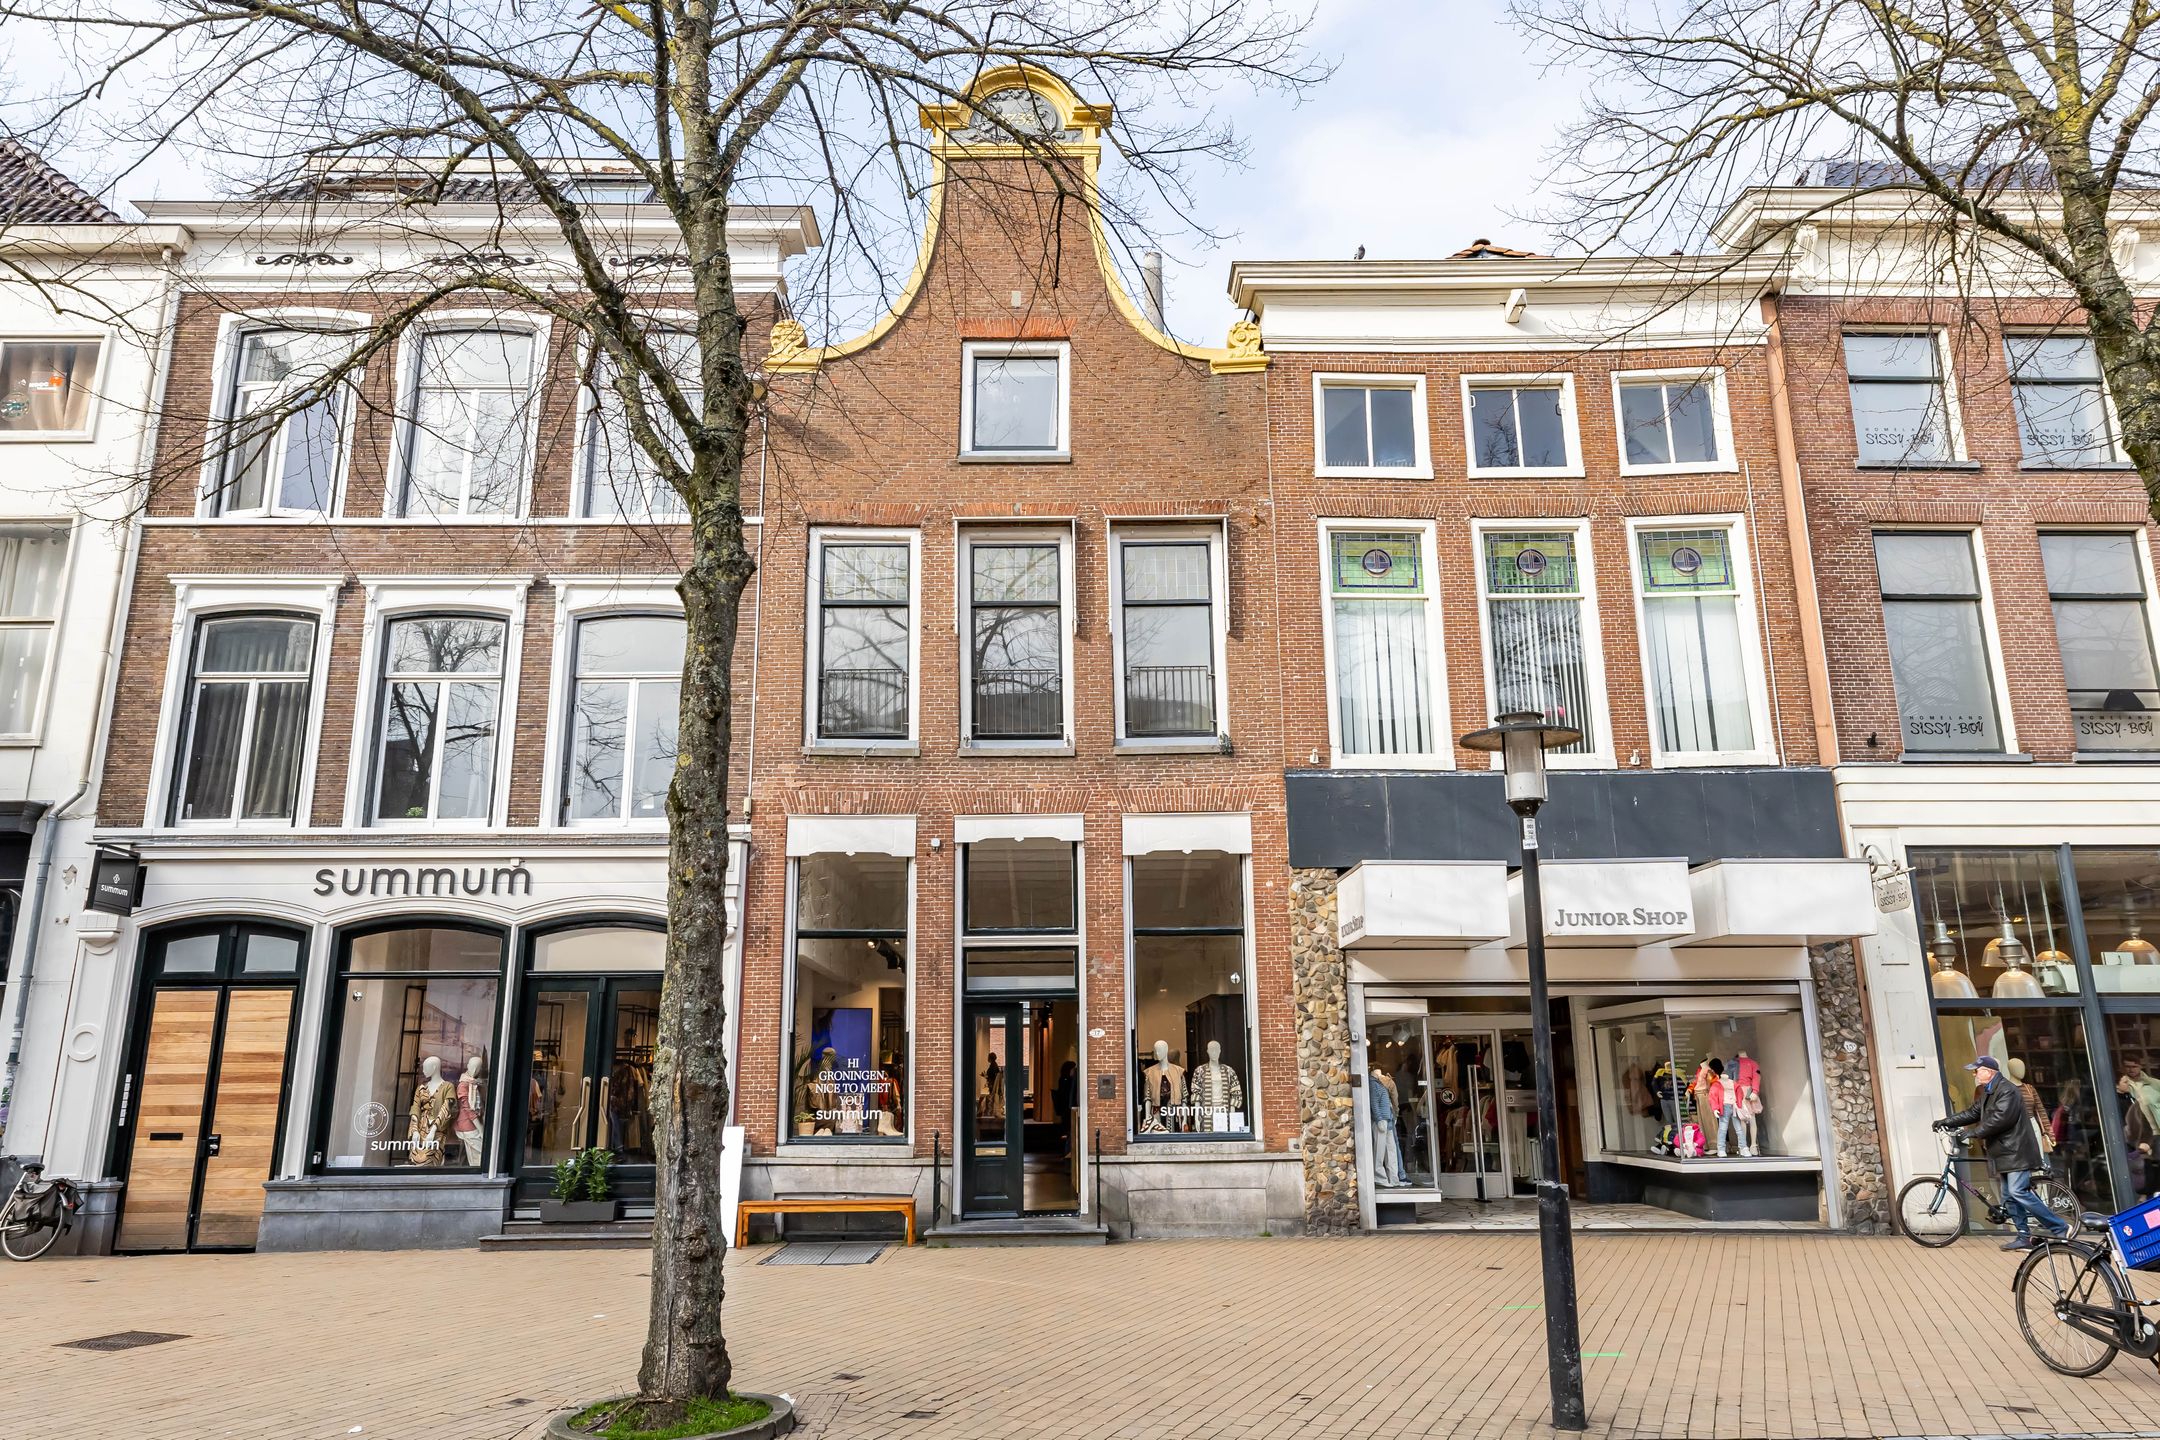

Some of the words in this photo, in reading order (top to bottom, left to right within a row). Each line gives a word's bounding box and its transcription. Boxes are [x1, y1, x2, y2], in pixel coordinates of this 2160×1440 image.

[313, 868, 531, 896] summum
[100, 884, 129, 896] summum
[847, 1058, 860, 1069] HI
[818, 1070, 888, 1082] GRONINGEN,
[815, 1083, 841, 1094] NICE
[842, 1083, 858, 1093] TO
[860, 1082, 891, 1093] MEET
[839, 1095, 865, 1106] YOU!
[816, 1109, 883, 1120] summum
[1160, 1105, 1227, 1117] summum
[370, 1140, 440, 1151] summum
